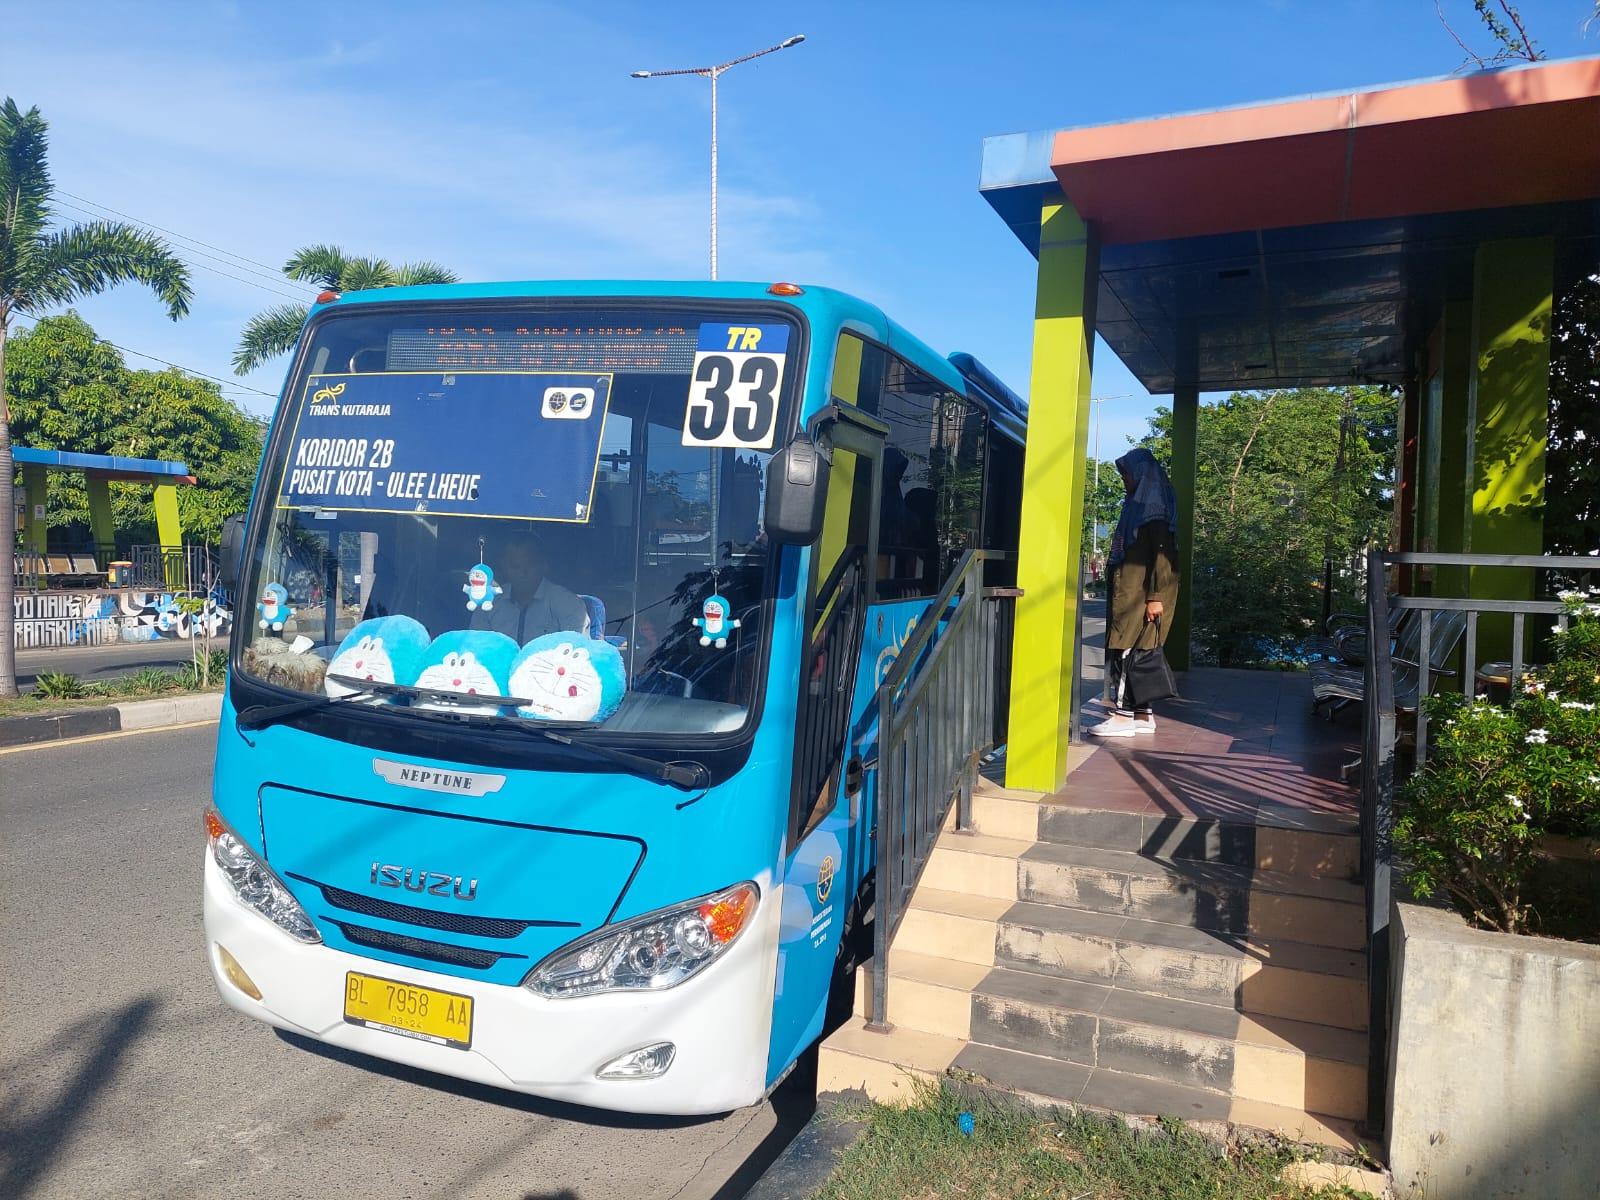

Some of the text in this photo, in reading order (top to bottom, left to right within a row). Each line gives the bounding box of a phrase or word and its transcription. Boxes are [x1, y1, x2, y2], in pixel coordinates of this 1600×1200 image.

[726, 326, 762, 351] TR
[309, 404, 391, 416] TRANS KUTARAJA
[688, 355, 779, 443] 33
[295, 438, 395, 468] KORIDOR 2B
[288, 468, 336, 495] PUSAT
[335, 470, 374, 497] KOTA
[386, 471, 428, 499] ULEE
[14, 596, 34, 618] YO
[400, 768, 473, 790] NEPTUNE
[370, 862, 478, 901] ISUZU
[348, 977, 467, 1027] BL 7958 AA
